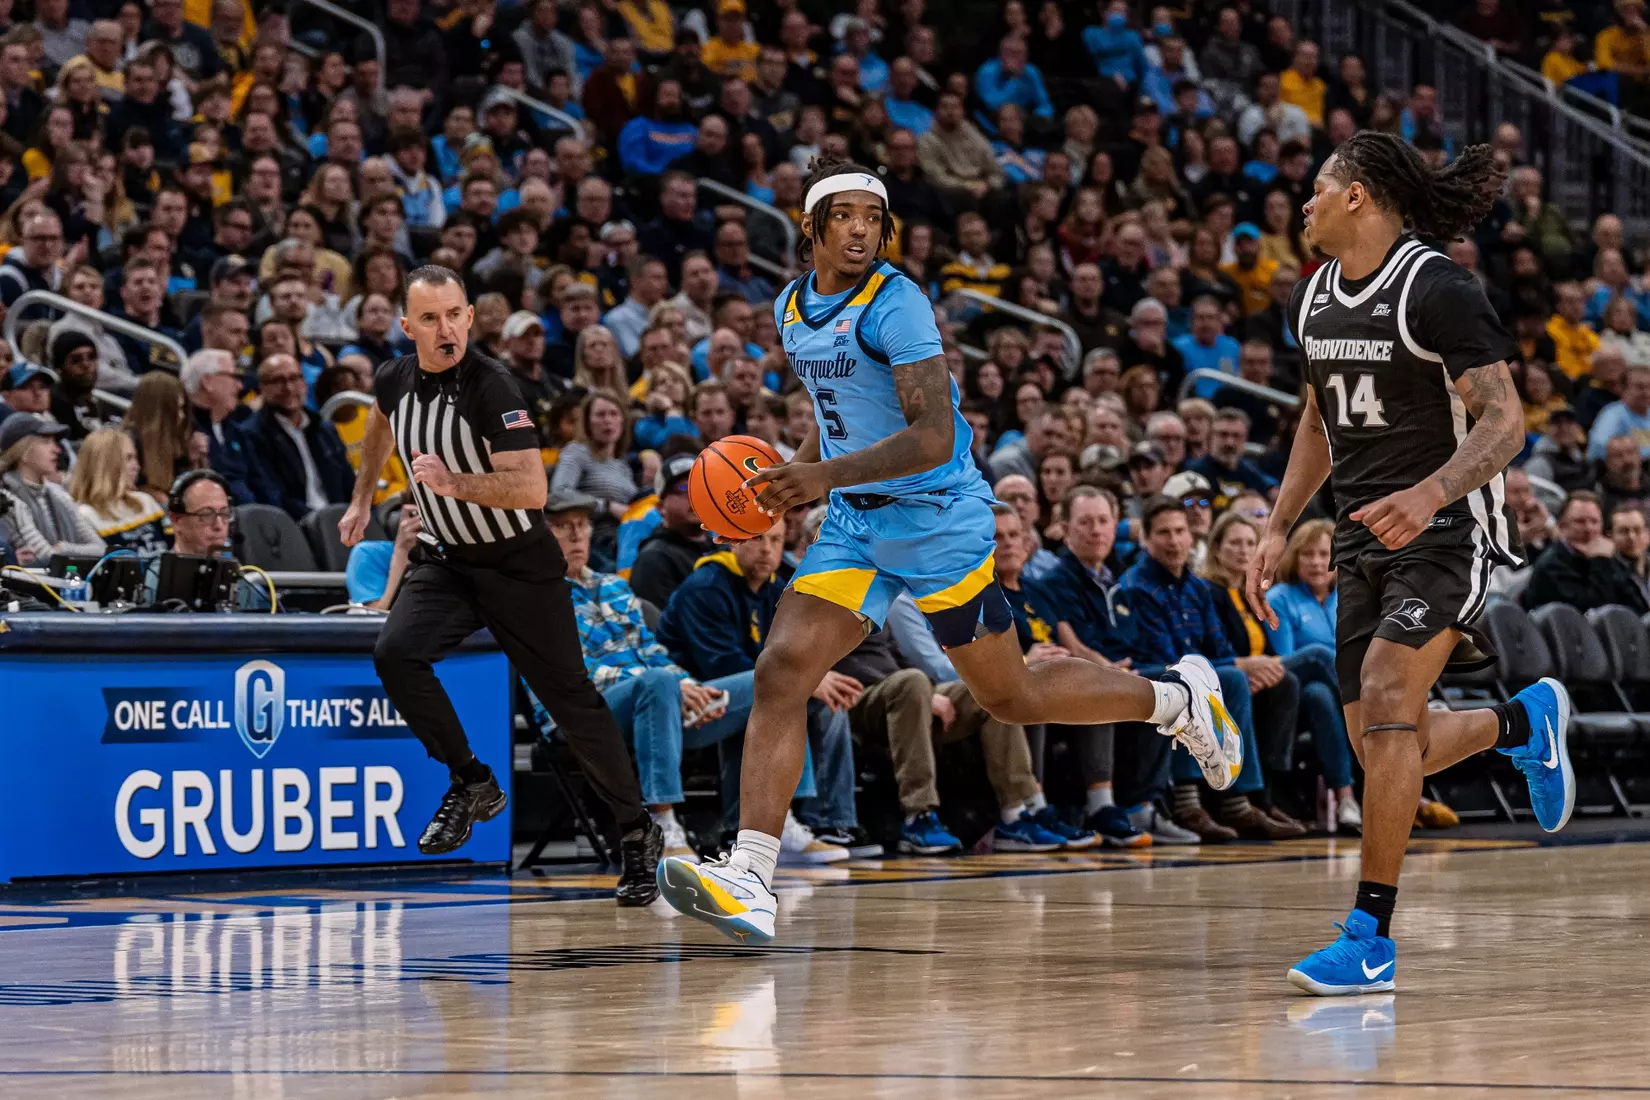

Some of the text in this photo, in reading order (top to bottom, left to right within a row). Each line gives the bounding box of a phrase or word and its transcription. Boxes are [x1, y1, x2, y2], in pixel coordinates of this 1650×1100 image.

[1305, 336, 1394, 361] PROVIDENCE
[786, 351, 857, 386] Marquette
[815, 389, 848, 440] 5
[1326, 373, 1390, 427] 14
[114, 700, 231, 731] ONE CALL
[286, 698, 364, 728] THAT'S
[114, 765, 406, 859] GRUBER
